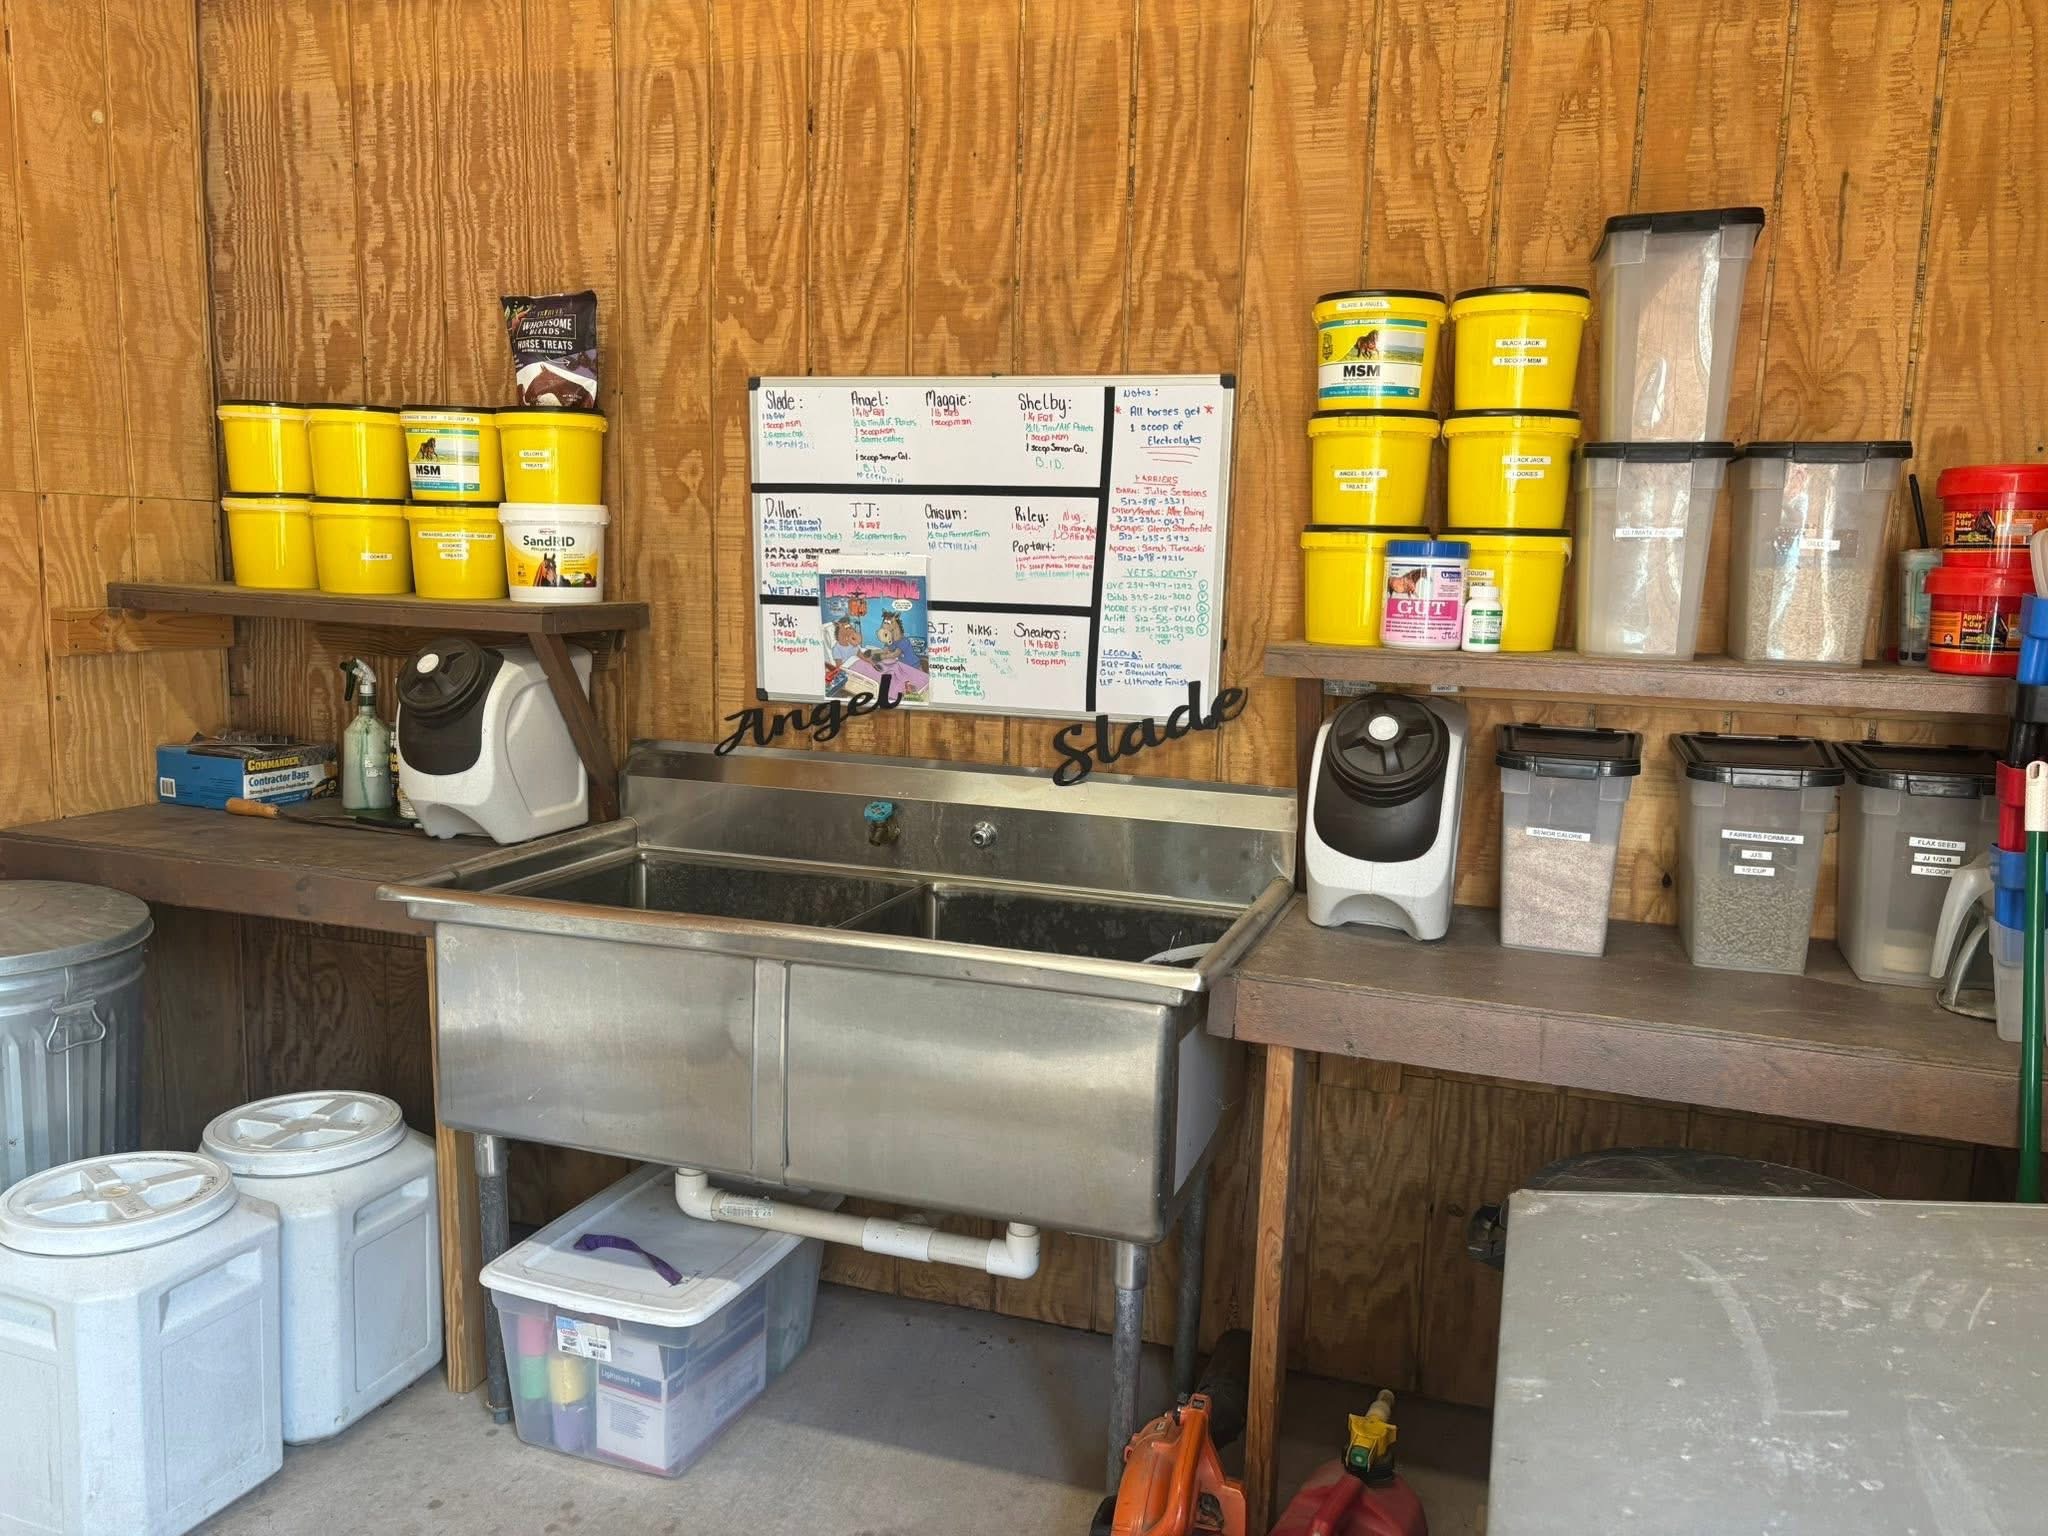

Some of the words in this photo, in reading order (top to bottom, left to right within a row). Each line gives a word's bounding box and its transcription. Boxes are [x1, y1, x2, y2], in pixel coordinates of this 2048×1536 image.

[523, 318, 572, 331] WHOLESOME
[517, 340, 541, 350] HORSE
[542, 340, 573, 350] TREATS
[1343, 365, 1381, 378] MSM
[766, 390, 803, 410] Slade:
[852, 390, 889, 413] Angel:
[926, 390, 971, 412] Maggie:
[1018, 393, 1071, 419] Shelby:
[1130, 406, 1143, 417] All
[1147, 408, 1180, 417] horses
[1184, 407, 1201, 418] get
[1141, 424, 1168, 433] scoop
[1172, 421, 1185, 431] of
[1031, 445, 1050, 455] scoop
[416, 465, 441, 475] MSM
[765, 497, 802, 518] Dillon:
[925, 503, 968, 520] Chisum:
[1015, 506, 1049, 527] Riley:
[1012, 540, 1055, 555] Poptart:
[768, 584, 792, 595] WET
[1397, 600, 1445, 615] GUT
[769, 612, 798, 628] Jack:
[714, 674, 902, 757] Angel
[1053, 681, 1248, 786] Slade
[248, 756, 300, 771] COMMANDER
[248, 773, 290, 787] Contractor
[291, 770, 310, 782] Bags
